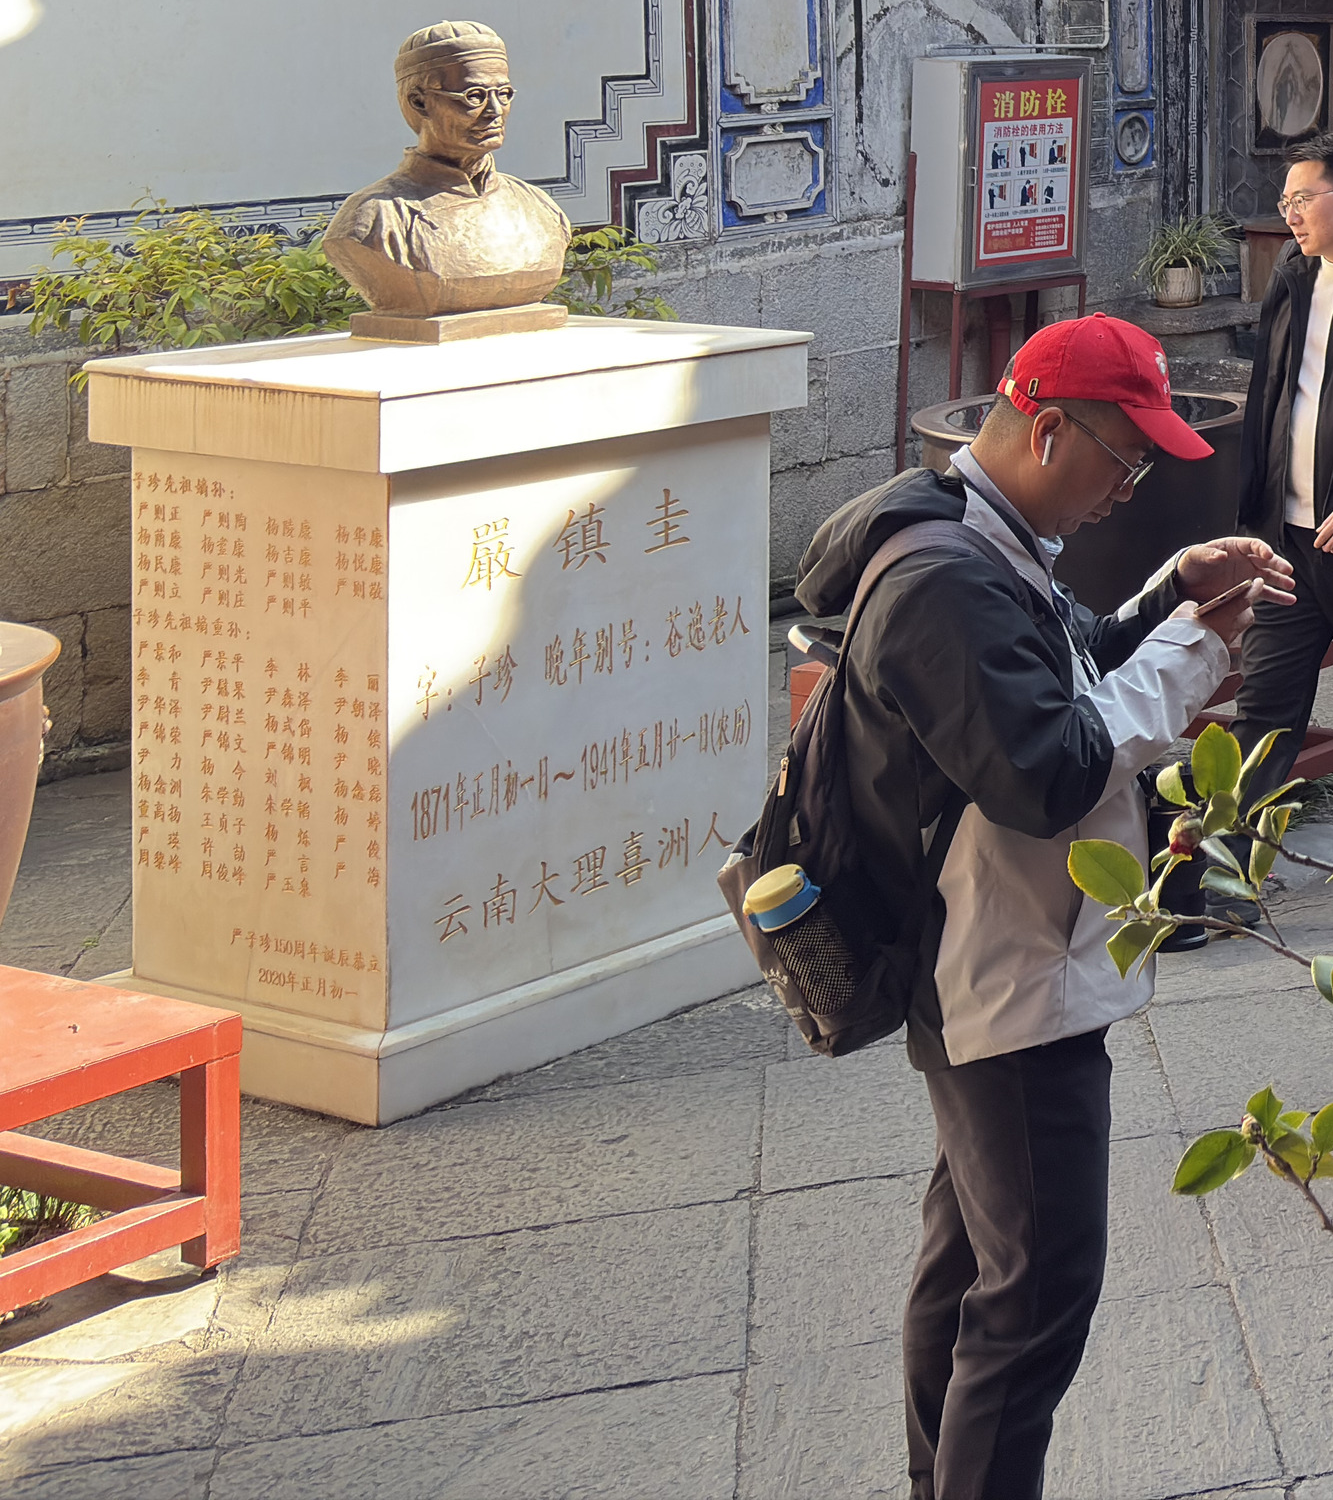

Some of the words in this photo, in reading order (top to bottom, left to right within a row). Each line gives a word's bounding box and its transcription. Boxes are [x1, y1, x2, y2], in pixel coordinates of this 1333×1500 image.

[992, 88, 1068, 119] 消防栓
[993, 122, 1064, 139] 消防栓的使用方法
[137, 501, 182, 522] 严则正
[335, 524, 384, 549] 杨华康
[265, 543, 312, 568] 杨吉康
[335, 551, 384, 576] 杨悦康
[137, 553, 183, 576] 杨民康
[201, 562, 248, 584] 严则光
[265, 569, 312, 592] 严则敏
[334, 578, 384, 600] 严则敬
[137, 578, 182, 599] 严则立
[201, 587, 246, 609] 严则庄
[264, 595, 312, 618] 严则平
[137, 640, 182, 664] 严景和
[201, 650, 246, 672] 严景平
[433, 812, 734, 944] 云南大理喜洲人
[258, 967, 358, 1000] 2020年正月初一
